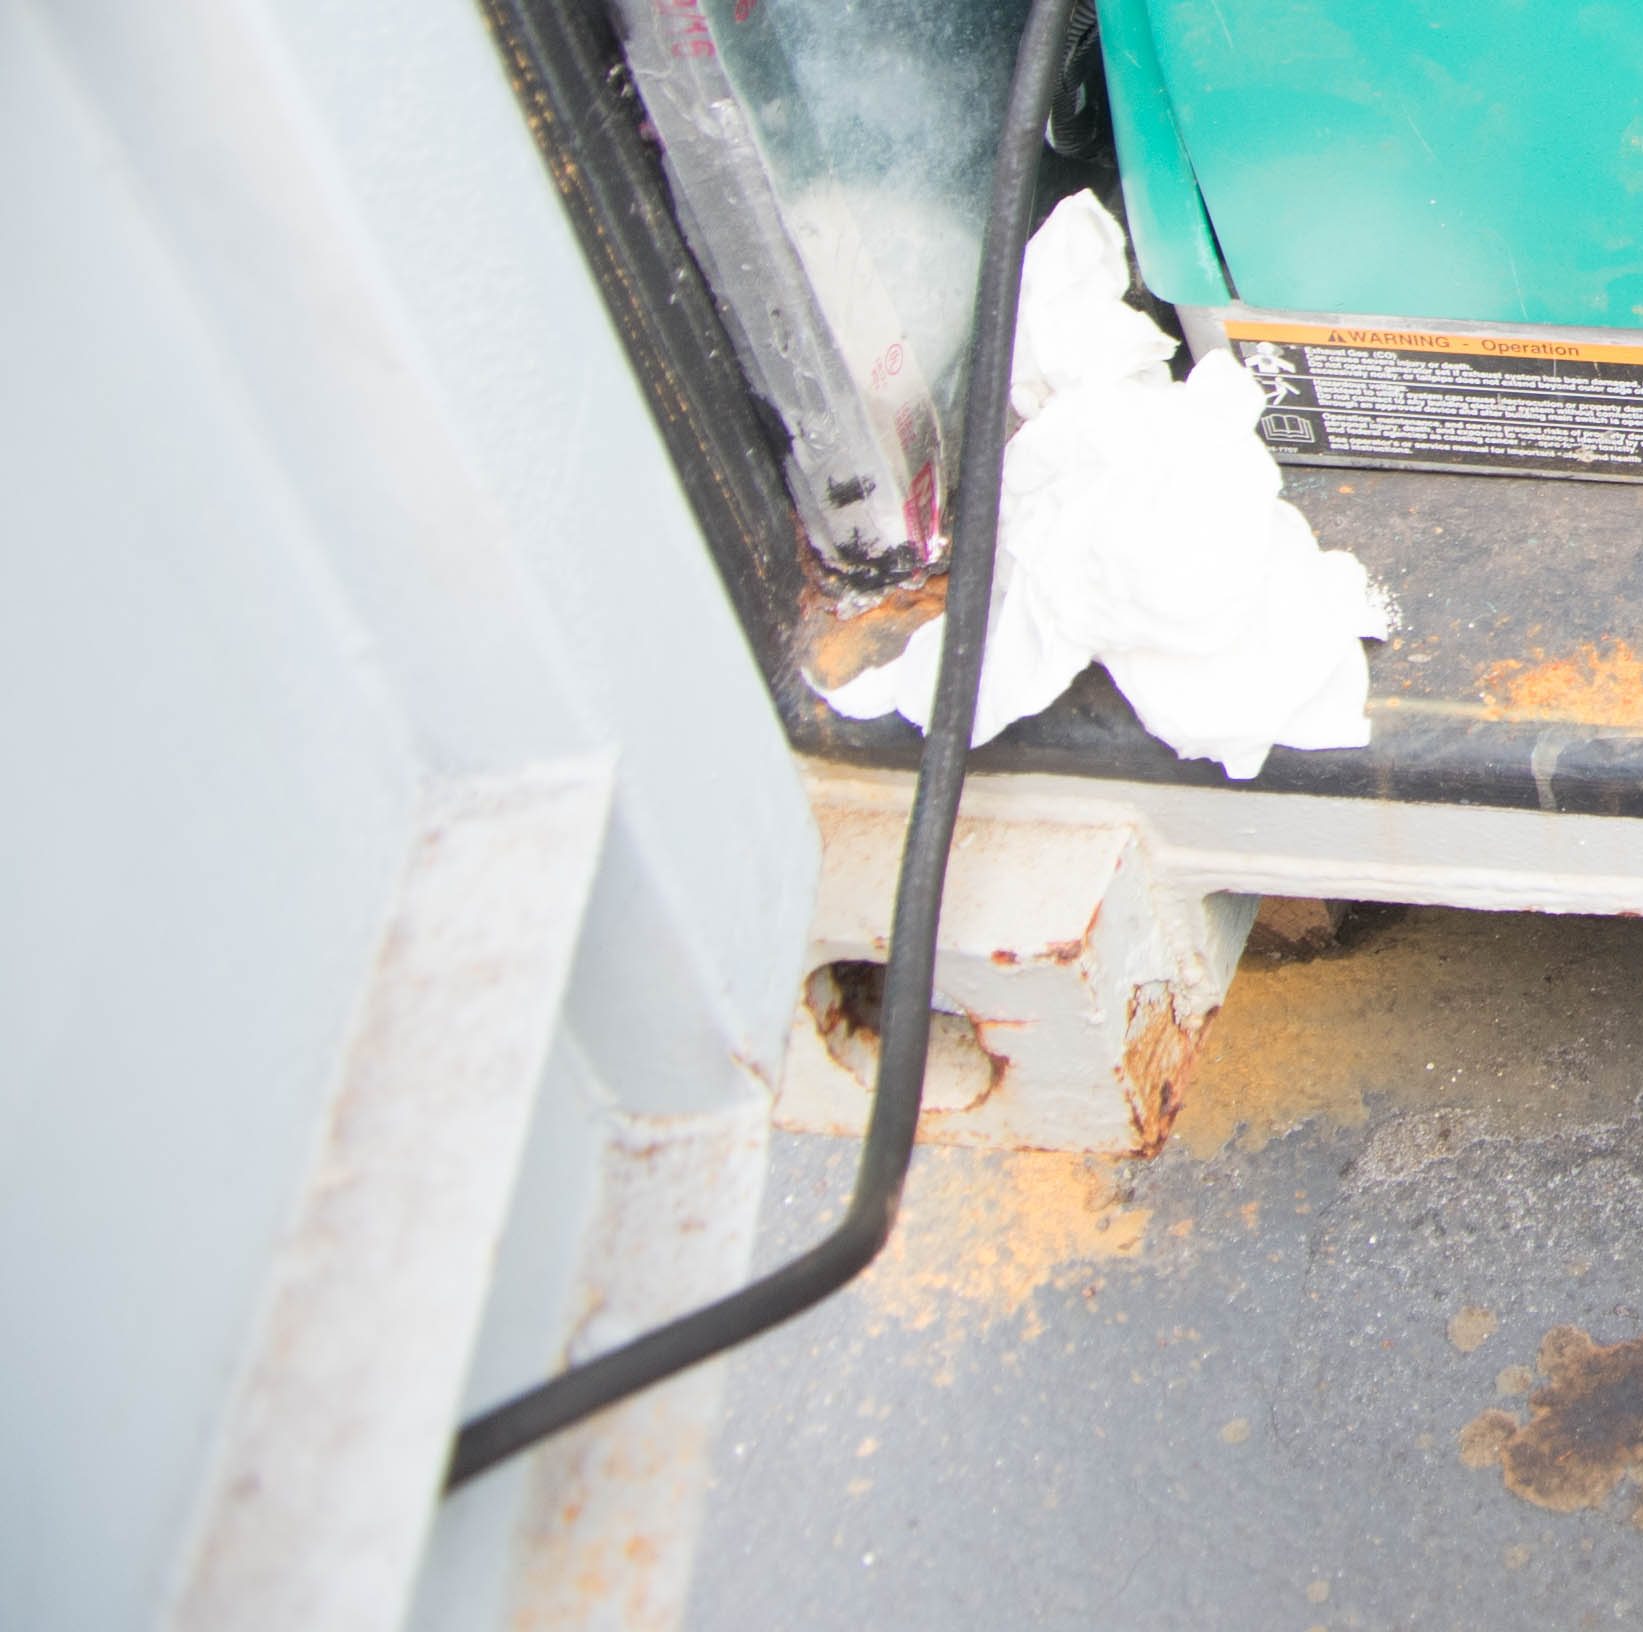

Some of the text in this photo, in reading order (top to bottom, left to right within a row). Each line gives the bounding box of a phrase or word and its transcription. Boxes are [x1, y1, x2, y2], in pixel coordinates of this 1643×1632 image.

[1349, 331, 1580, 358] WARNING Operation
[1372, 350, 1397, 359] (CO)
[1306, 353, 1327, 361] Can
[1328, 355, 1359, 363] cause
[1324, 361, 1342, 369] not
[1342, 362, 1382, 372] operate
[1434, 368, 1450, 376] set
[1461, 370, 1502, 379] exhaust
[1503, 373, 1540, 383] system
[1563, 377, 1589, 385] been
[1415, 374, 1454, 384] tailpipe
[1482, 378, 1499, 386] not
[1500, 380, 1536, 388] extend
[1537, 382, 1576, 392] beyond
[1577, 385, 1604, 393] outer
[1606, 387, 1632, 395] edge
[1332, 393, 1350, 401] not
[1351, 394, 1392, 403] connect
[1406, 398, 1425, 407] any
[1556, 408, 1594, 417] without
[1362, 388, 1375, 396] to
[1406, 391, 1443, 401] system
[1464, 395, 1496, 404] cause
[1578, 403, 1622, 413] property
[1374, 403, 1422, 413] approved
[1423, 406, 1457, 414] device
[1504, 411, 1546, 421] building
[1547, 414, 1573, 422] main
[1574, 416, 1608, 424] switch
[1326, 426, 1345, 434] and
[1346, 428, 1381, 436] federal
[1382, 430, 1428, 440] agencies
[1442, 434, 1483, 444] causing
[1484, 437, 1518, 445] cancer
[1368, 423, 1401, 432] injury,
[1402, 425, 1434, 433] death,
[1455, 428, 1503, 438] exposure
[1624, 440, 1638, 448] by
[1444, 421, 1464, 429] and
[1464, 422, 1502, 431] service
[1503, 425, 1542, 435] present
[1543, 428, 1568, 436] risks
[1569, 429, 1582, 437] of
[1328, 435, 1348, 443] See
[1413, 441, 1450, 450] service
[1451, 443, 1489, 452] manual
[1506, 447, 1555, 458] important
[1610, 454, 1642, 462] health
